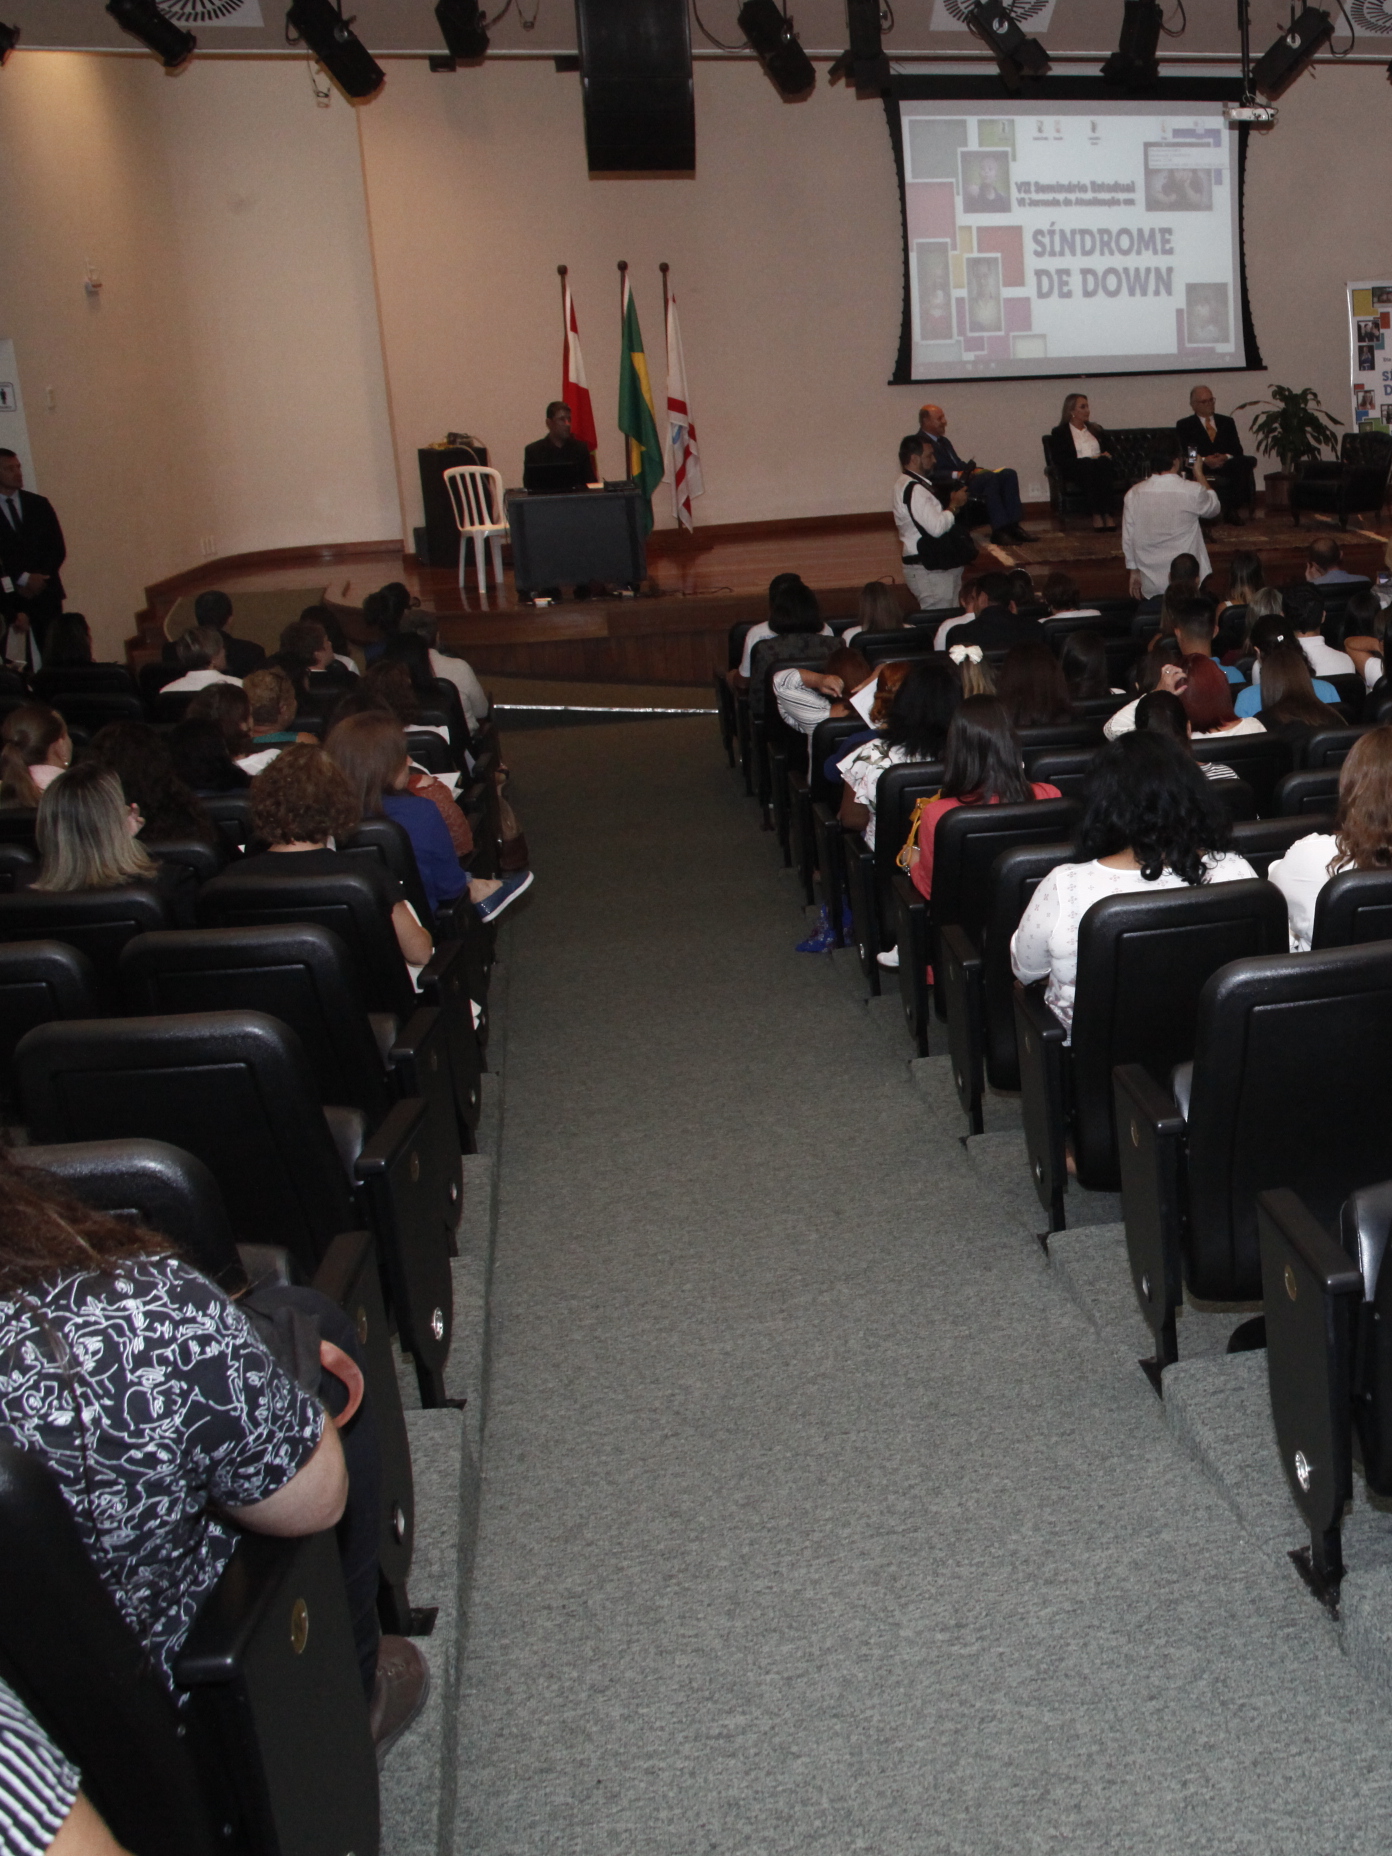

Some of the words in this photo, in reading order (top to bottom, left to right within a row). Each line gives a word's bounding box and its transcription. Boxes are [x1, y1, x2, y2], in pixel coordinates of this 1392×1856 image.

[1032, 221, 1174, 258] SÍNDROME
[1034, 267, 1073, 299] DE
[1079, 266, 1174, 298] DOWN
